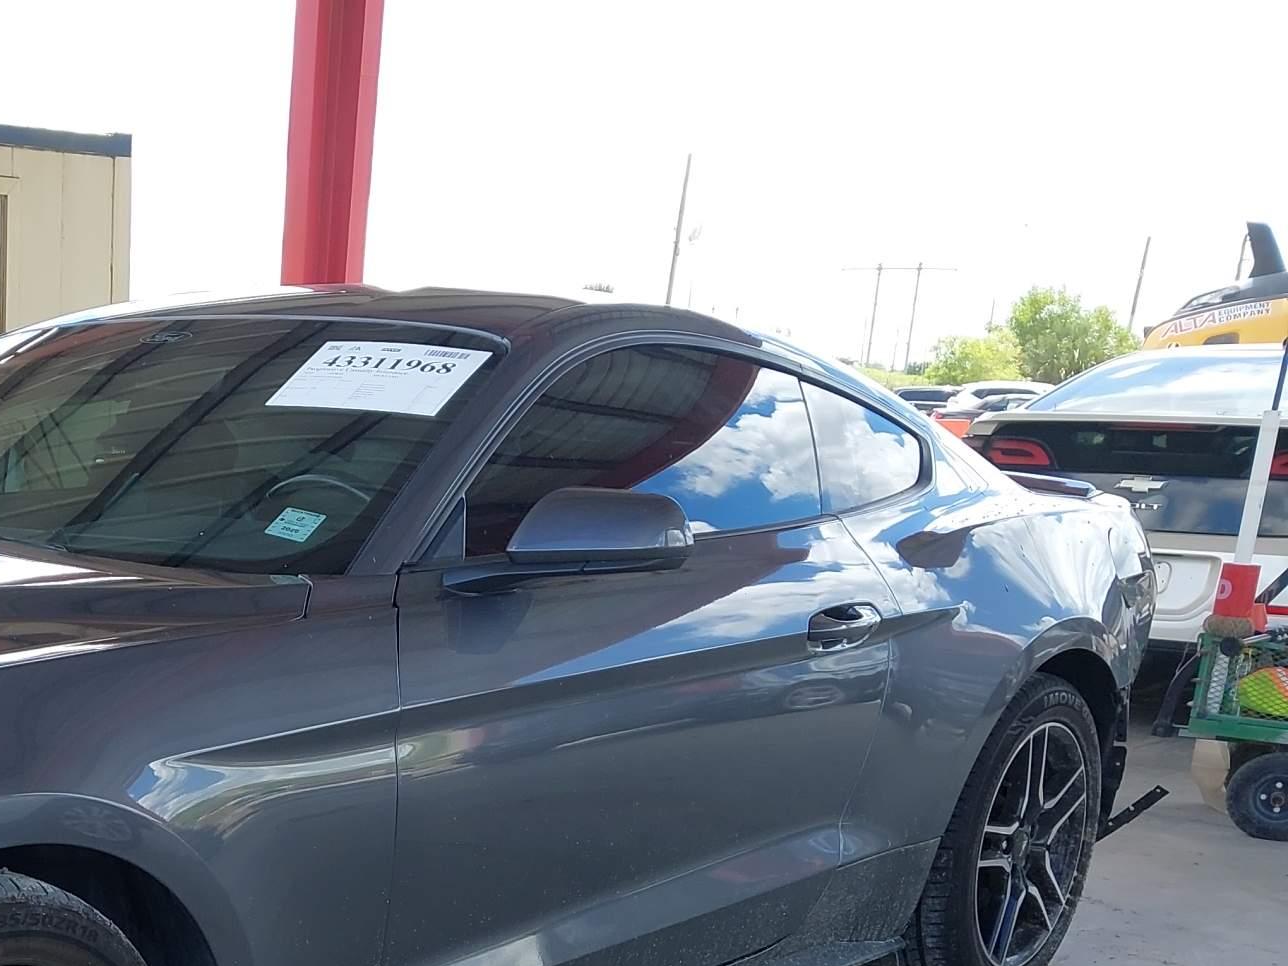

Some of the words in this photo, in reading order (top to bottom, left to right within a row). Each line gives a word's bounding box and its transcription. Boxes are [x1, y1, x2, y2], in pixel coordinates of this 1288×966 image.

[1218, 301, 1272, 317] EQUIPMENT
[1218, 308, 1271, 323] COMPANY
[1161, 311, 1217, 338] ALTA
[322, 354, 457, 375] 43311968
